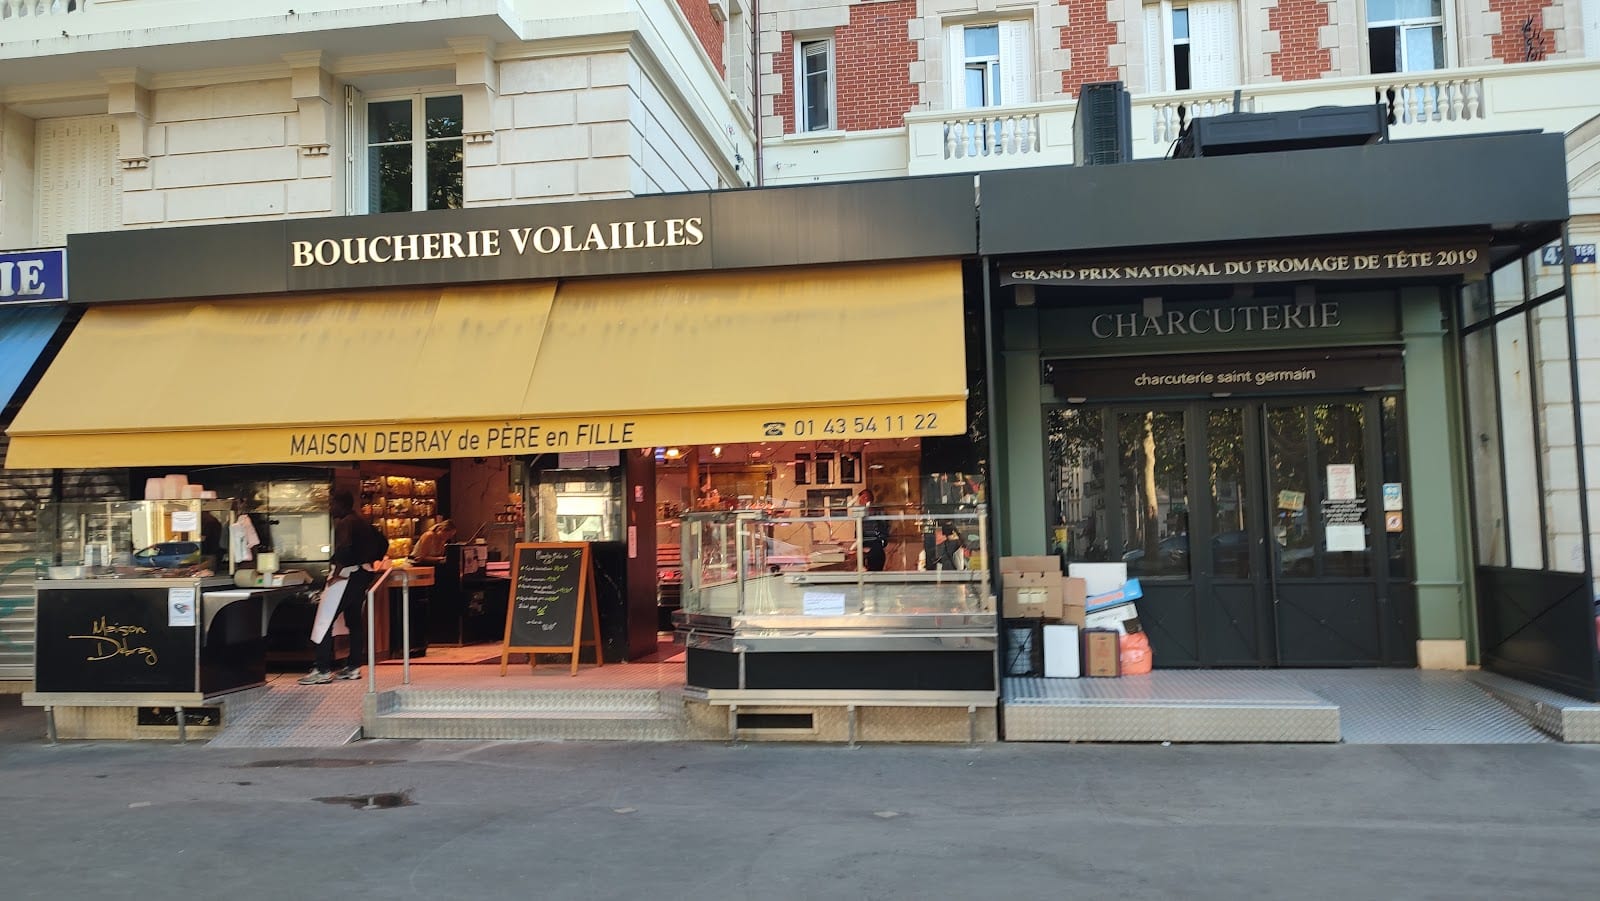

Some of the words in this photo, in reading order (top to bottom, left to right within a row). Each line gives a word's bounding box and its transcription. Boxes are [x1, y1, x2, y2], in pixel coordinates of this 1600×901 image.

[291, 229, 501, 268] BOUCHERIE
[508, 217, 705, 256] VOLAILLES
[1543, 246, 1567, 265] 4
[1574, 245, 1596, 257] TER
[1011, 269, 1075, 281] GRAND
[1079, 266, 1121, 280] PRIX
[1124, 262, 1221, 279] NATIONAL
[1224, 260, 1251, 275] DU
[1255, 255, 1350, 274] FROMAGE
[1353, 253, 1381, 270] DE
[1383, 250, 1433, 269] TÊTE
[1436, 248, 1479, 267] 2019
[1090, 301, 1342, 339] CHARCUTERIE
[1134, 371, 1214, 387] charcuterie
[1216, 370, 1252, 384] saint
[1254, 366, 1317, 386] germain
[793, 420, 815, 436] 01
[823, 418, 847, 434] 43
[853, 416, 878, 434] 54
[885, 414, 905, 432] 11
[914, 412, 939, 431] 22
[289, 432, 368, 456] MAISON
[373, 429, 453, 454] DEBRAY
[457, 429, 481, 451] de
[486, 422, 541, 450] PÈRE
[545, 430, 569, 447] en
[575, 422, 636, 445] FILLE
[91, 615, 148, 637] Maison
